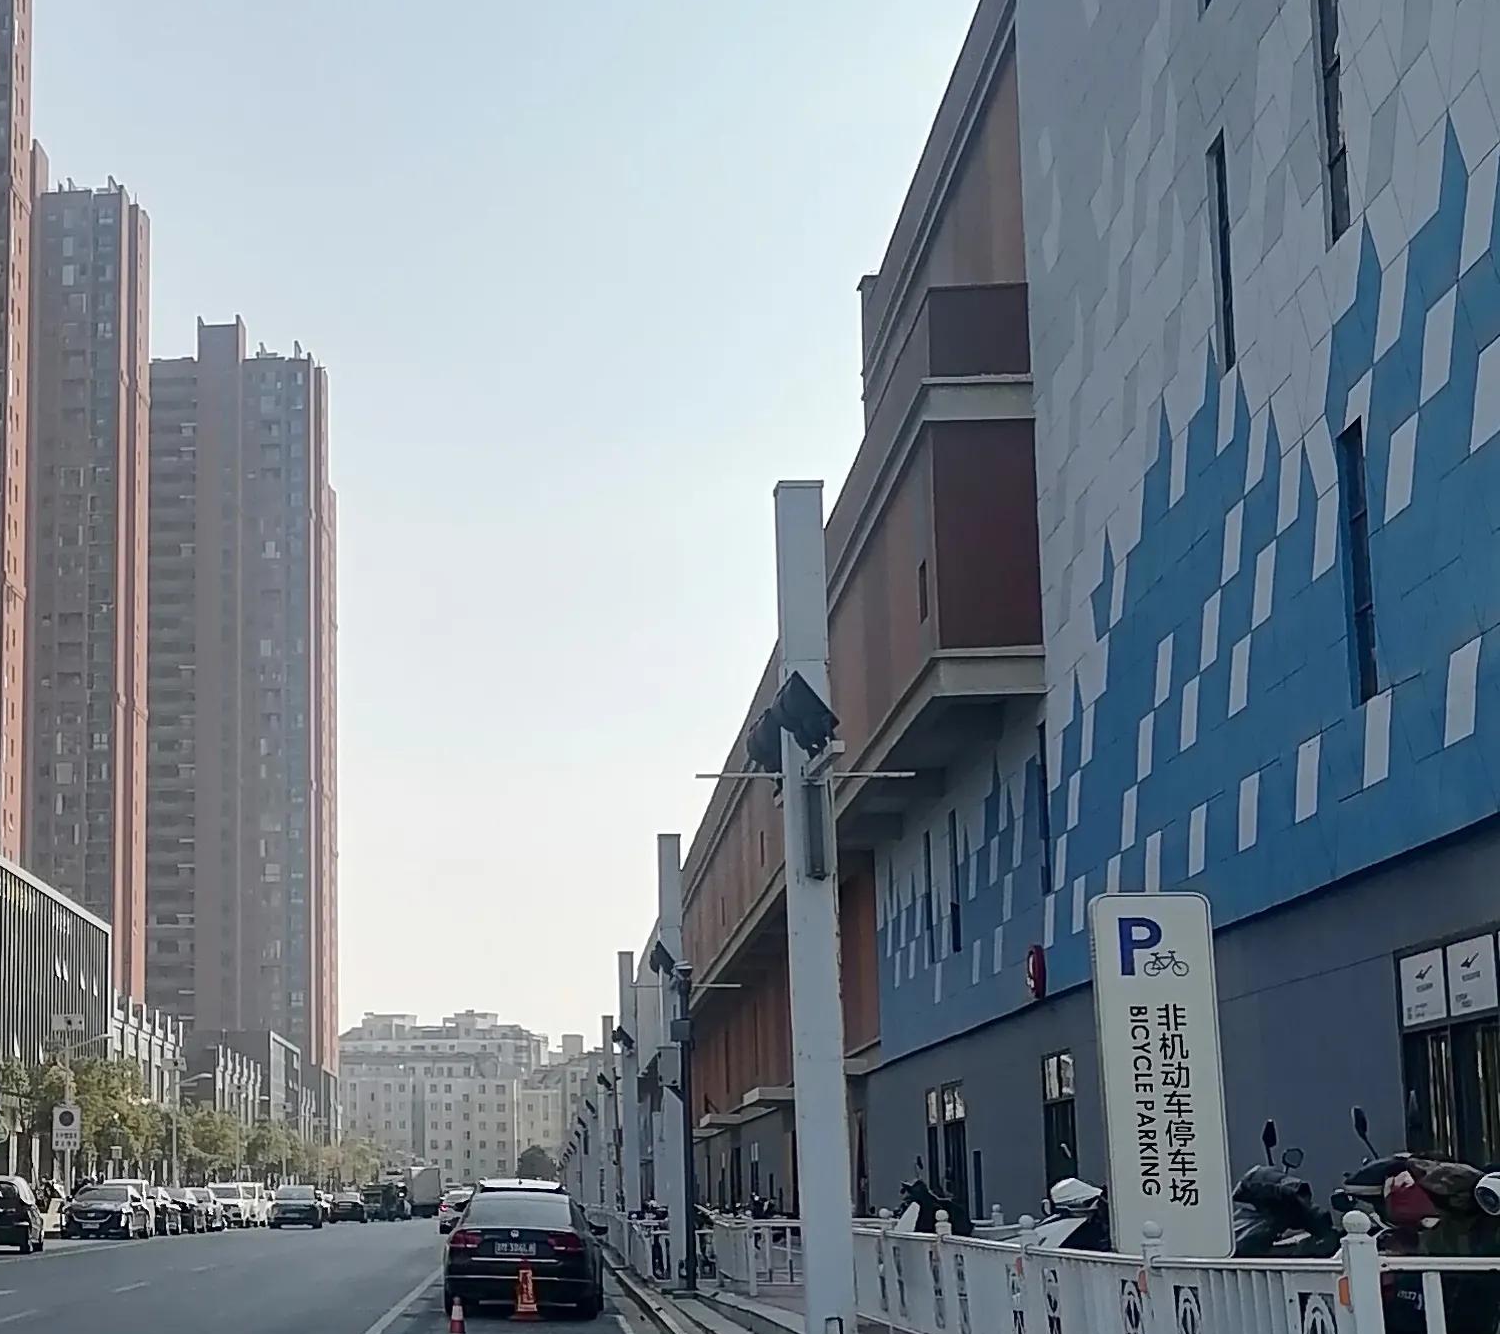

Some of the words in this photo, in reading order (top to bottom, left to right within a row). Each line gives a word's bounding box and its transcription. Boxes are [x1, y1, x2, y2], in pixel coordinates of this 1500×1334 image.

[1117, 917, 1162, 976] P
[1129, 1005, 1154, 1093] BICYCLE
[1135, 1099, 1161, 1197] PARKING
[1156, 1003, 1199, 1207] 非机动车停车场
